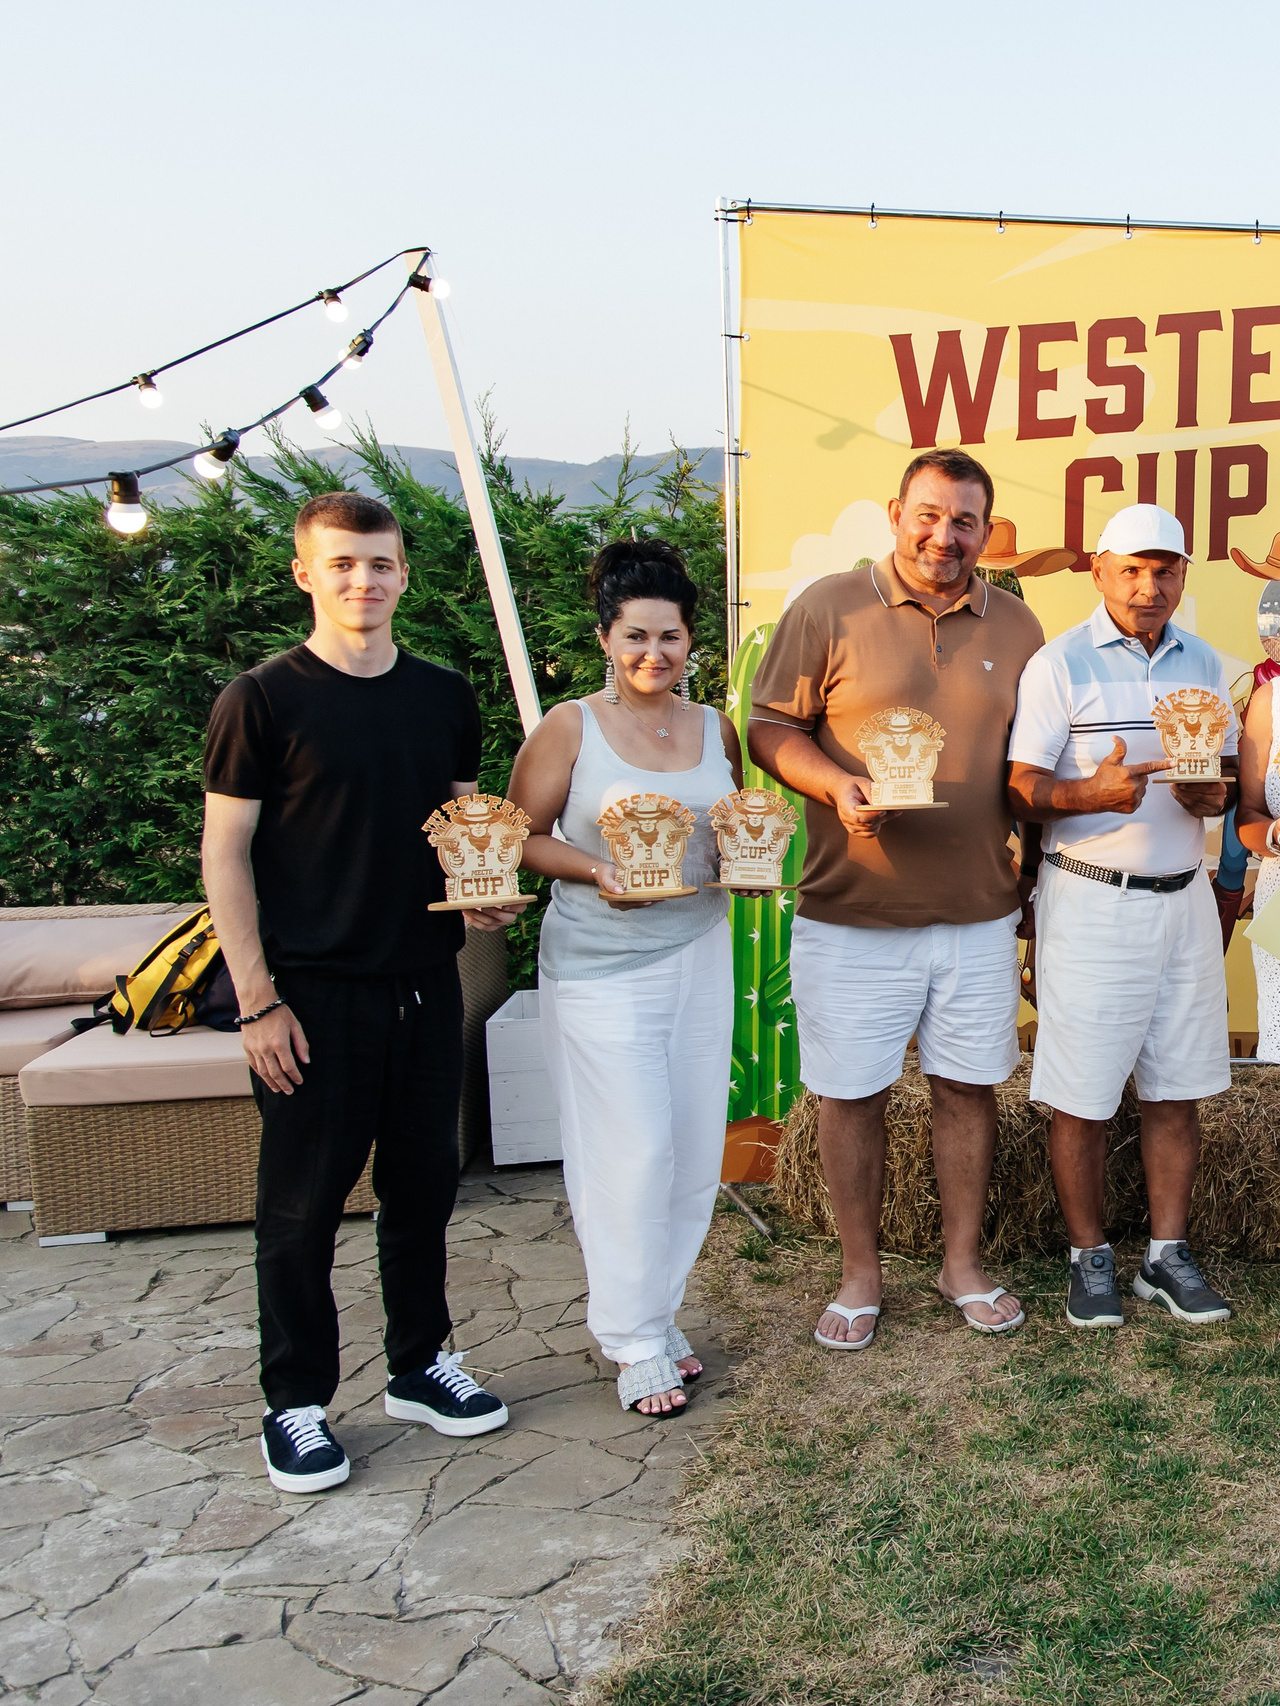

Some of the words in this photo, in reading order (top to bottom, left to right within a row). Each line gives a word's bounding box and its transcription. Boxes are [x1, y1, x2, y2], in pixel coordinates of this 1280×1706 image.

[1064, 444, 1268, 572] CUP
[1190, 740, 1196, 750] 2
[889, 766, 915, 778] CUP
[1177, 759, 1209, 774] CUP
[645, 849, 652, 860] 3
[740, 846, 767, 859] CUP
[477, 855, 485, 867] 3
[630, 870, 669, 887] CUP
[461, 877, 503, 897] CUP
